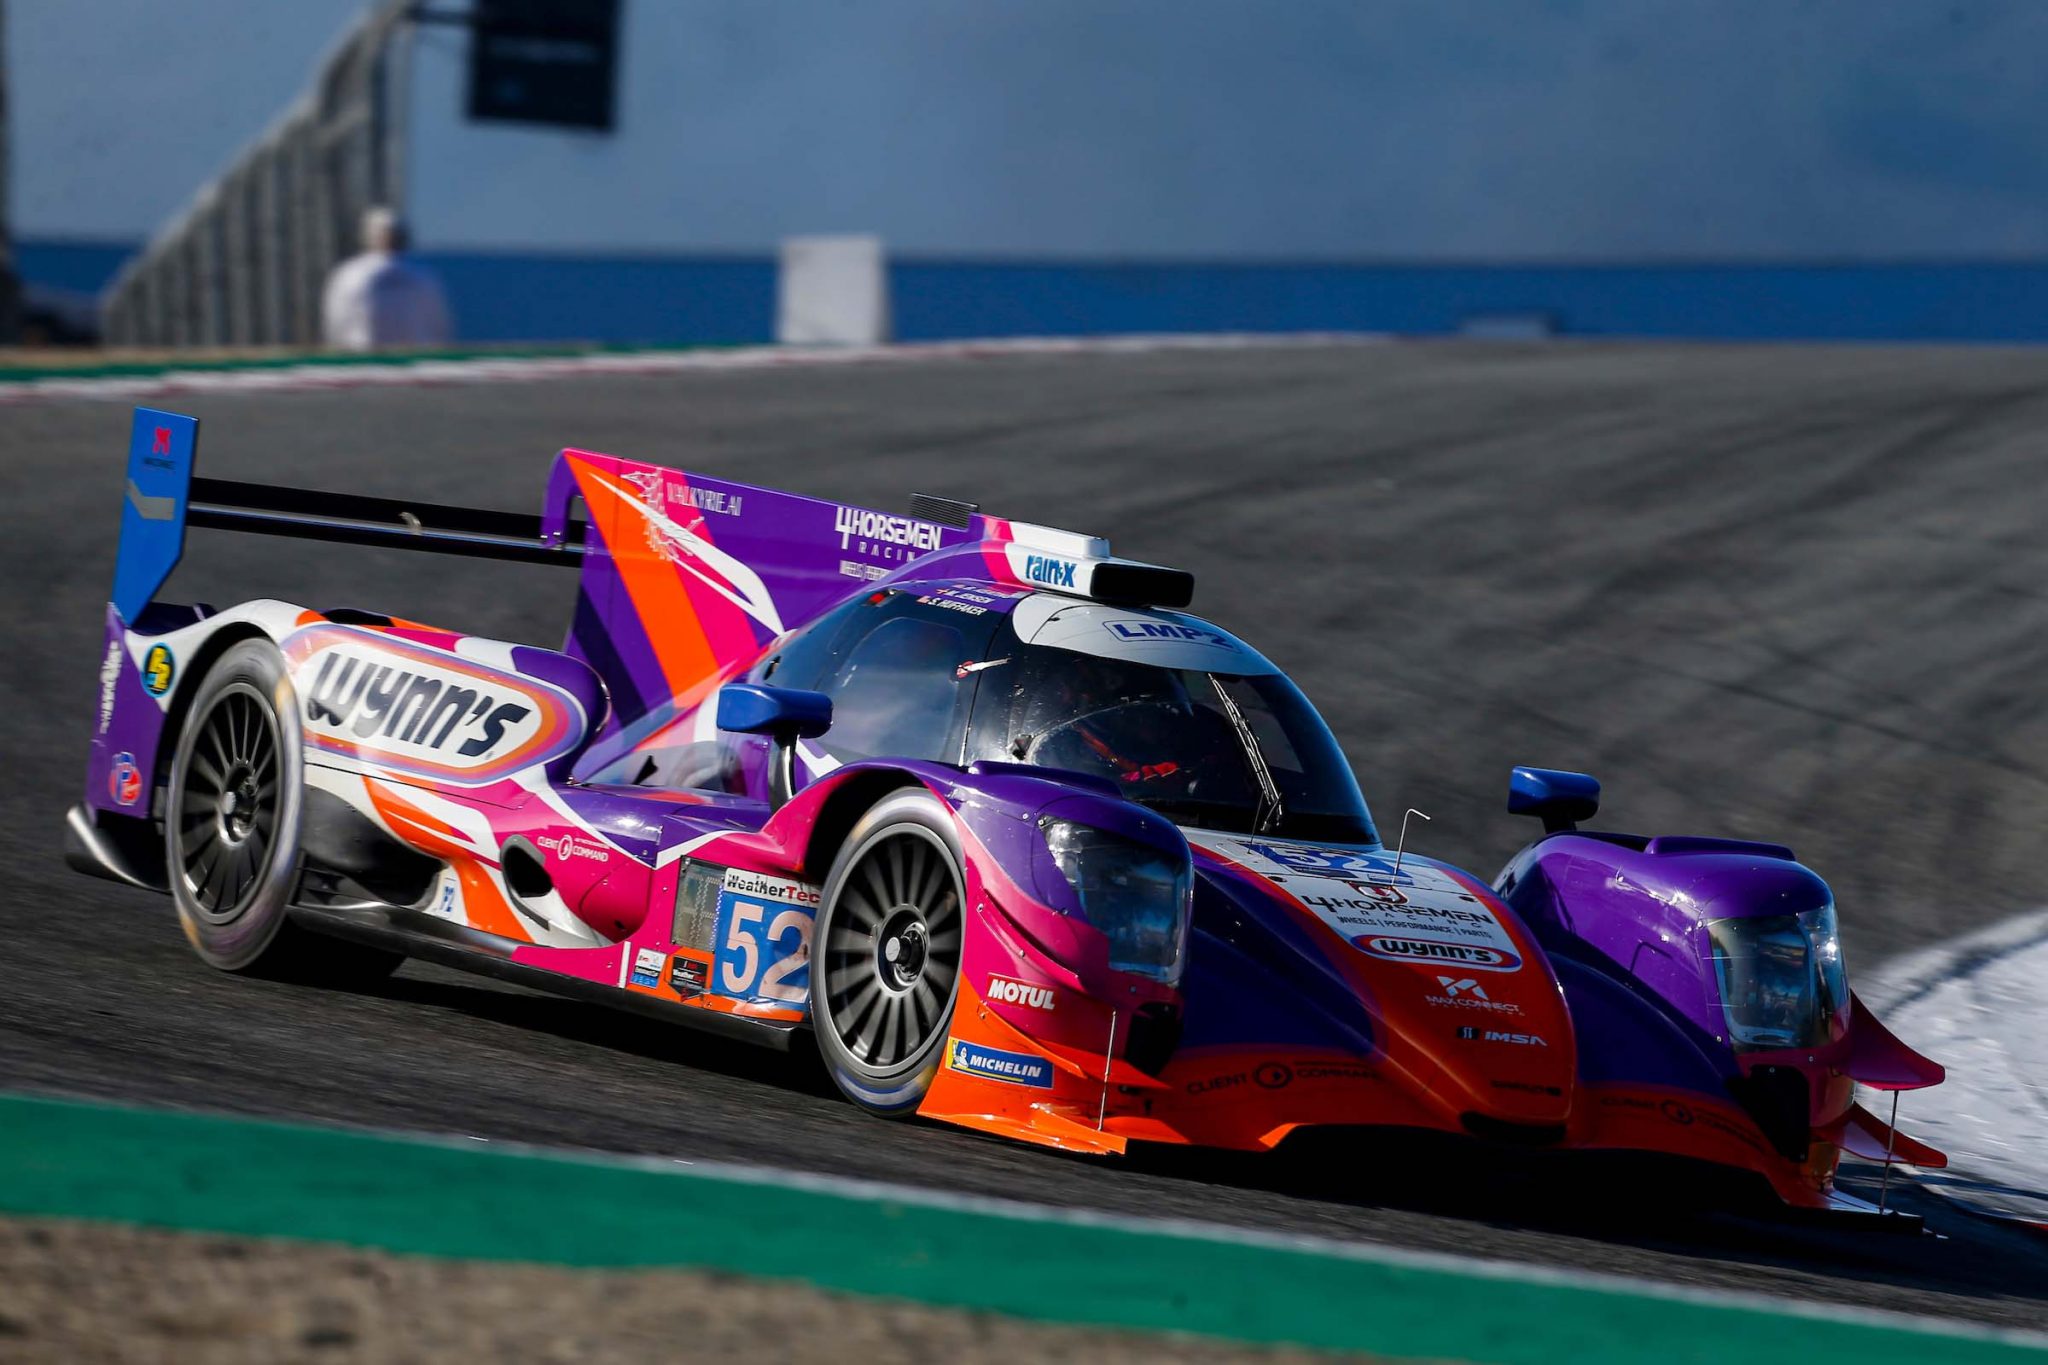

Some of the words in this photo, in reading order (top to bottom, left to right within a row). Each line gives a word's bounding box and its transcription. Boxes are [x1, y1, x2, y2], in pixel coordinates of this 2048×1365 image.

[835, 507, 942, 551] 4HORSEMEN
[858, 541, 916, 562] RACIN
[1112, 624, 1233, 649] LMP2
[1272, 846, 1390, 874] 52
[727, 874, 820, 904] WeatherTec
[1301, 895, 1495, 925] 4HORSEMEN
[1337, 915, 1378, 926] WHEELS
[1384, 920, 1454, 936] PERFORMANCE
[722, 901, 815, 1003] 52
[987, 979, 1055, 1010] MOTUL
[1485, 1031, 1547, 1046] IMSA
[970, 1055, 1042, 1078] MICHELIN
[1296, 1067, 1386, 1083] COMMA
